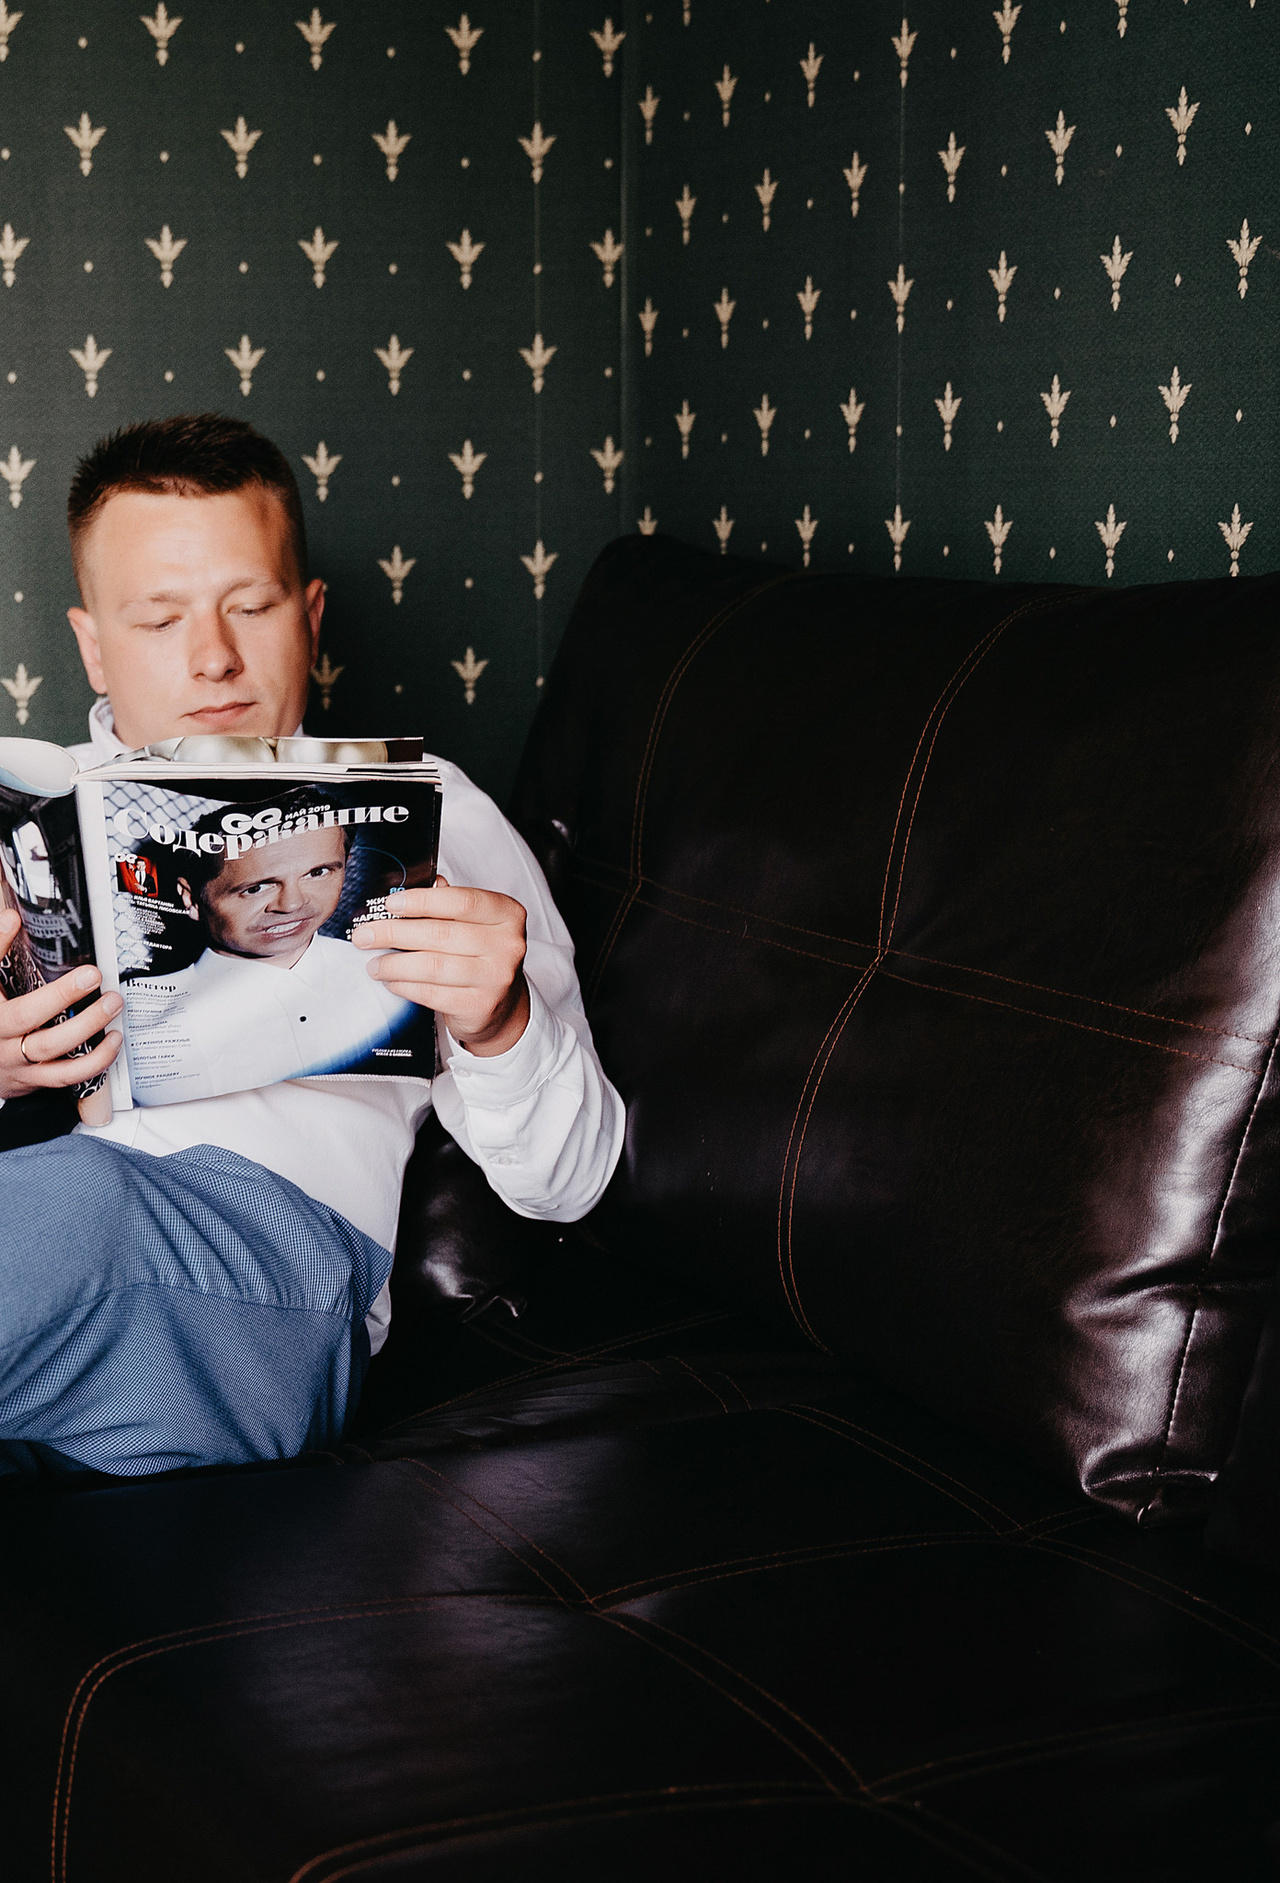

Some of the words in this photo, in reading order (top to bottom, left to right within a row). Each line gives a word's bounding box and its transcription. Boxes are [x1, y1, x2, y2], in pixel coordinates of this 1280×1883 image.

[221, 807, 282, 835] GQ
[284, 808, 307, 821] МАЙ
[307, 804, 331, 815] 2019
[113, 804, 410, 861] Содержание
